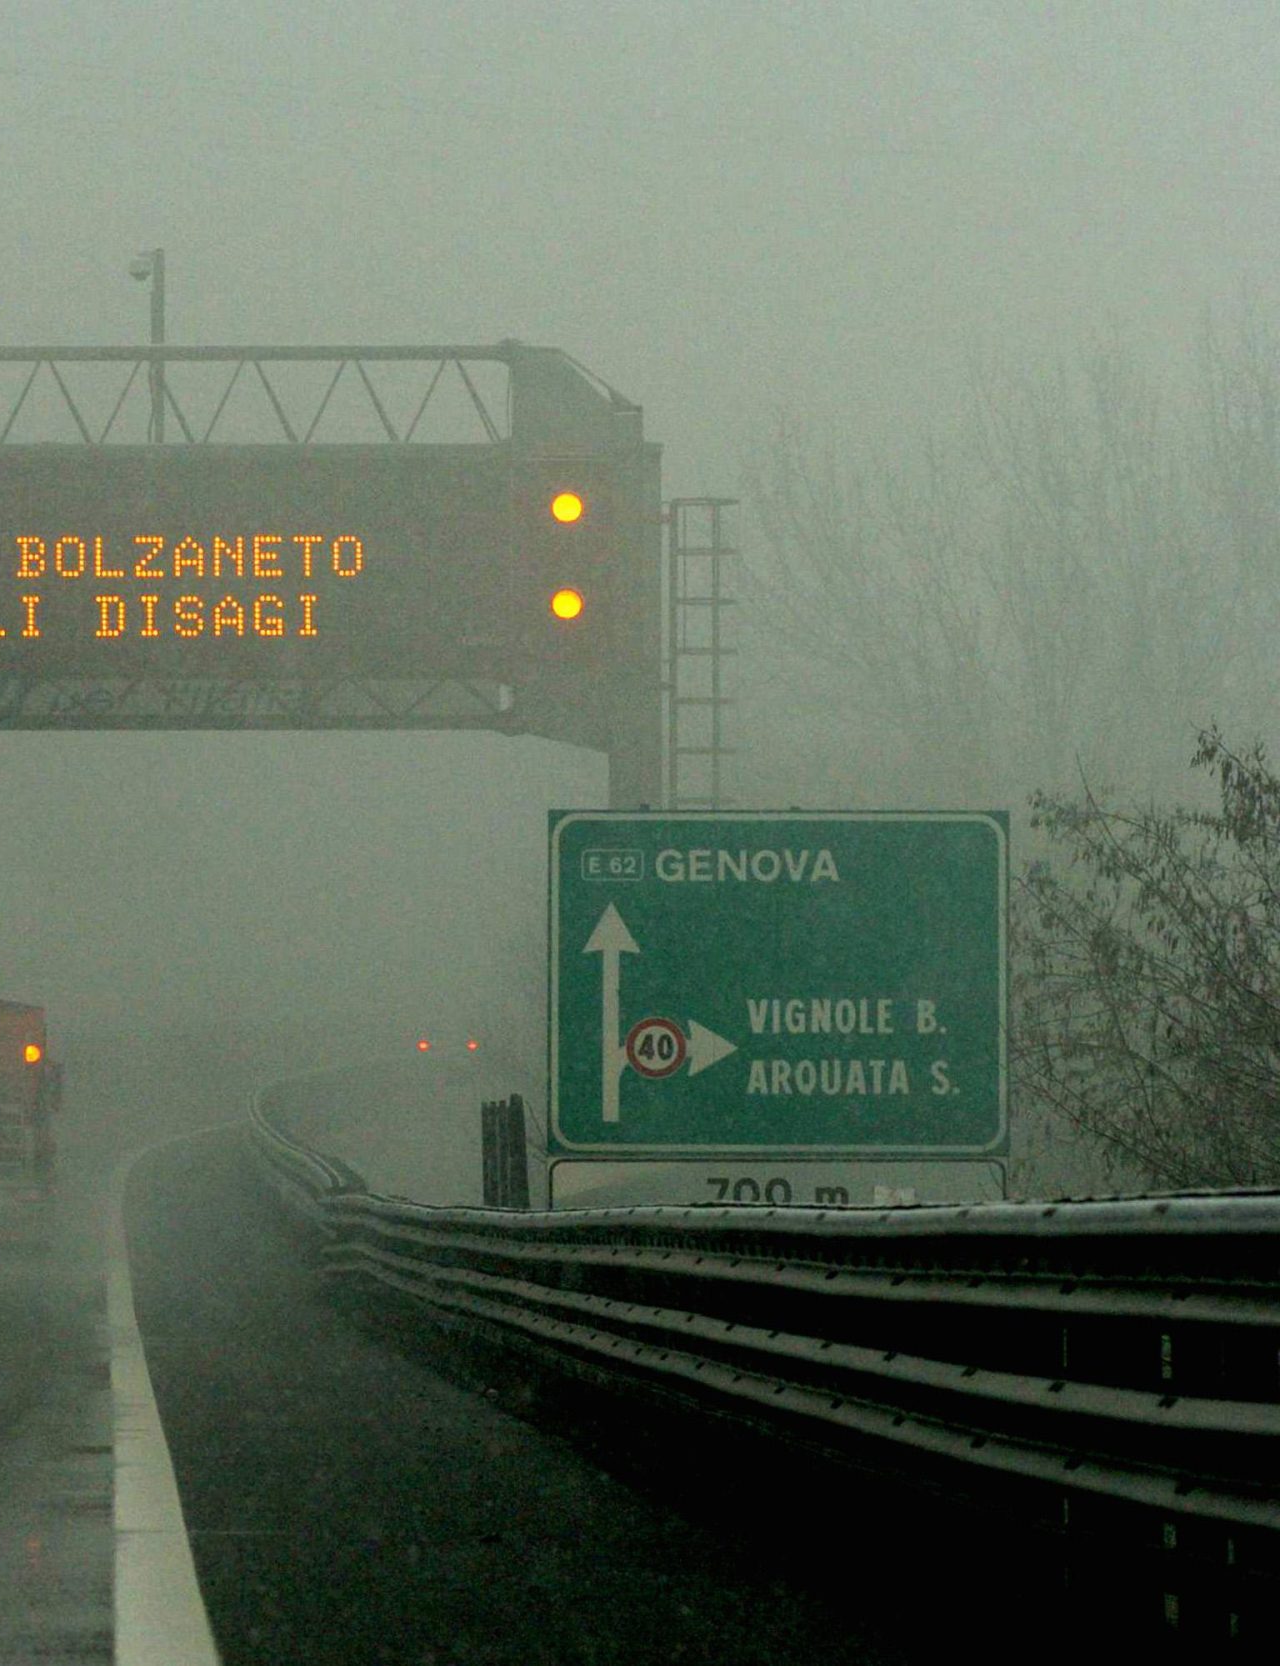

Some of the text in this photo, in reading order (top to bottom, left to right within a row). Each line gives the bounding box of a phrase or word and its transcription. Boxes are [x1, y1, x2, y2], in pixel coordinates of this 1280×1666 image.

[15, 533, 364, 580] BOLZANETO
[95, 593, 319, 639] DISAGI
[588, 857, 636, 874] E 62
[655, 848, 840, 882] GENOVA
[746, 999, 947, 1034] VIGNOLE B.
[637, 1033, 674, 1061] 40
[746, 1060, 961, 1095] ARQUATA S.
[707, 1177, 848, 1204] 700 m
